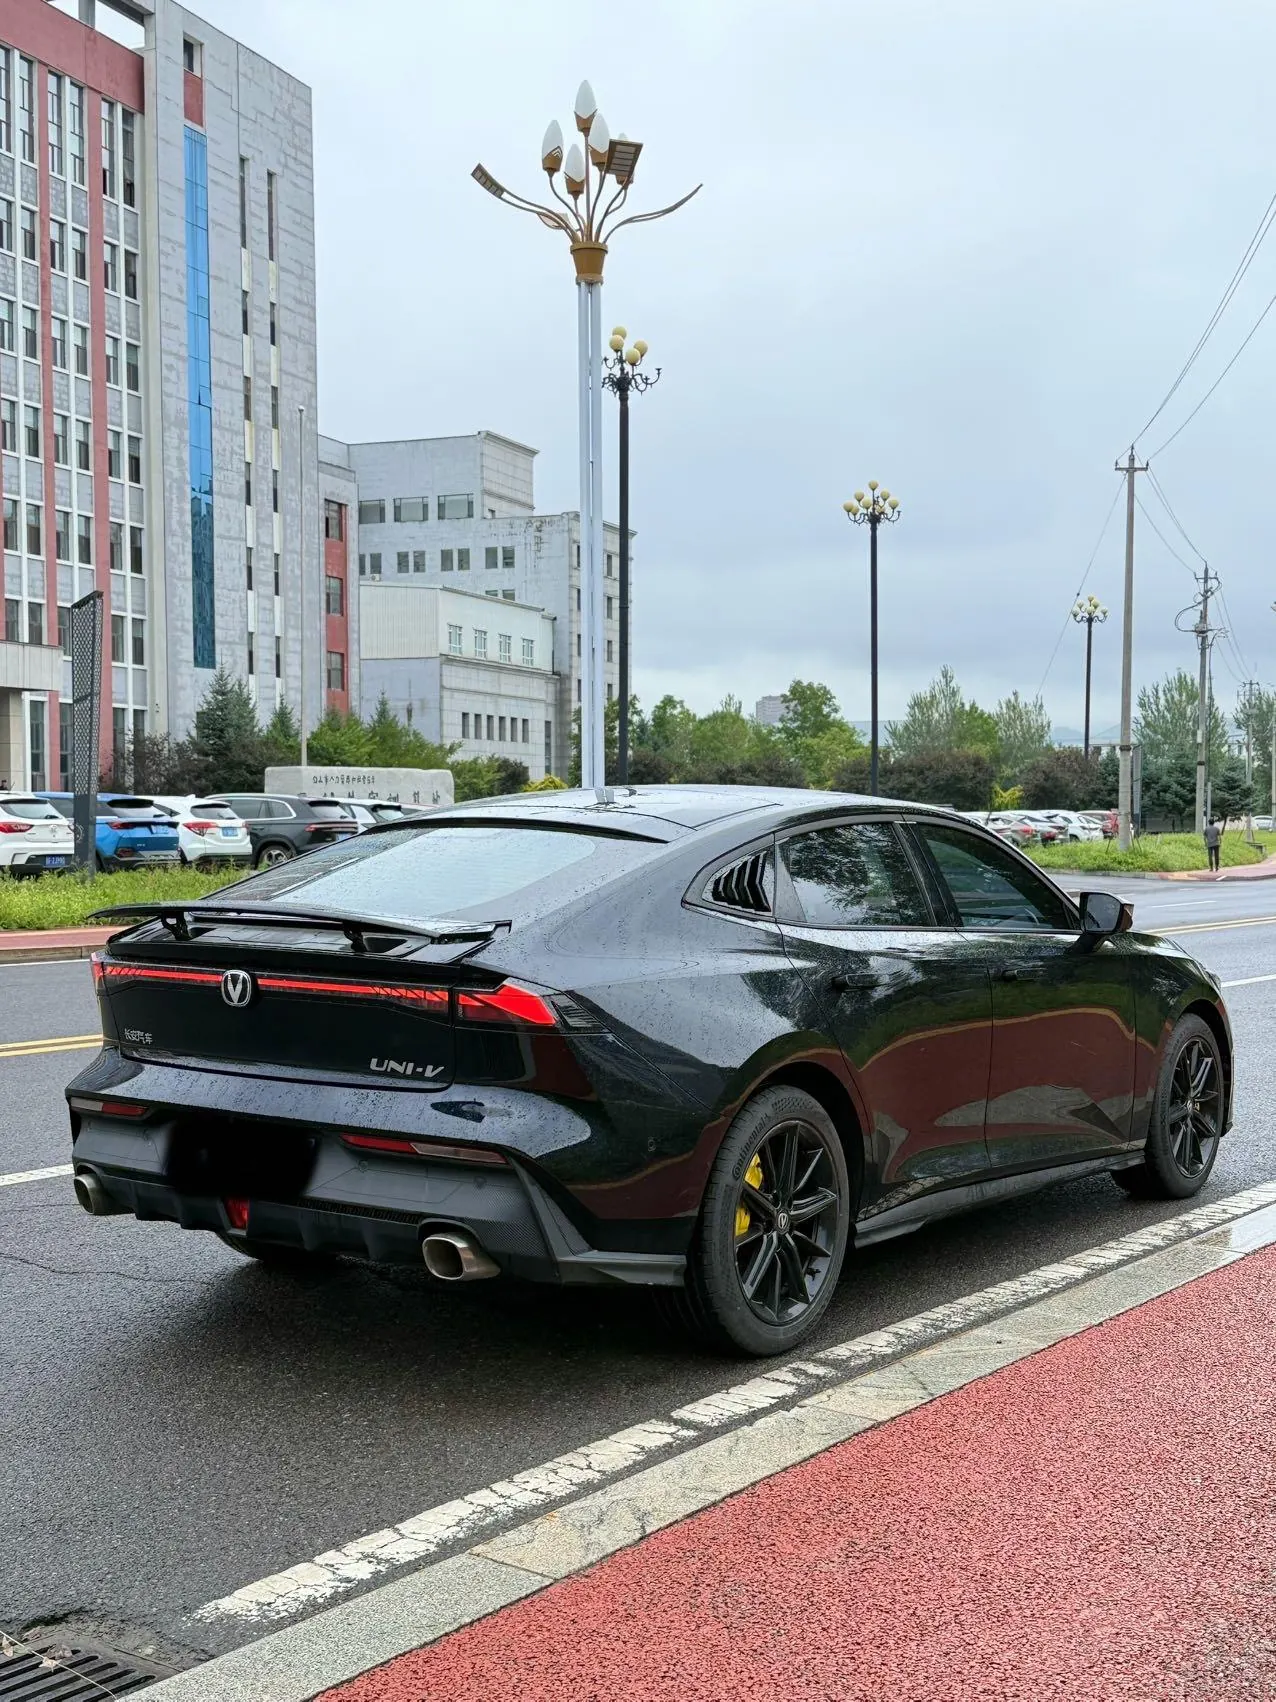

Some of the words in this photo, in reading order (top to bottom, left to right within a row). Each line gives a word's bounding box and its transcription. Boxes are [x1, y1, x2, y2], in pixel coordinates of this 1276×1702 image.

[124, 1028, 153, 1045] 长安汽车
[369, 1057, 445, 1078] UNI-V
[732, 1117, 767, 1181] Continental
